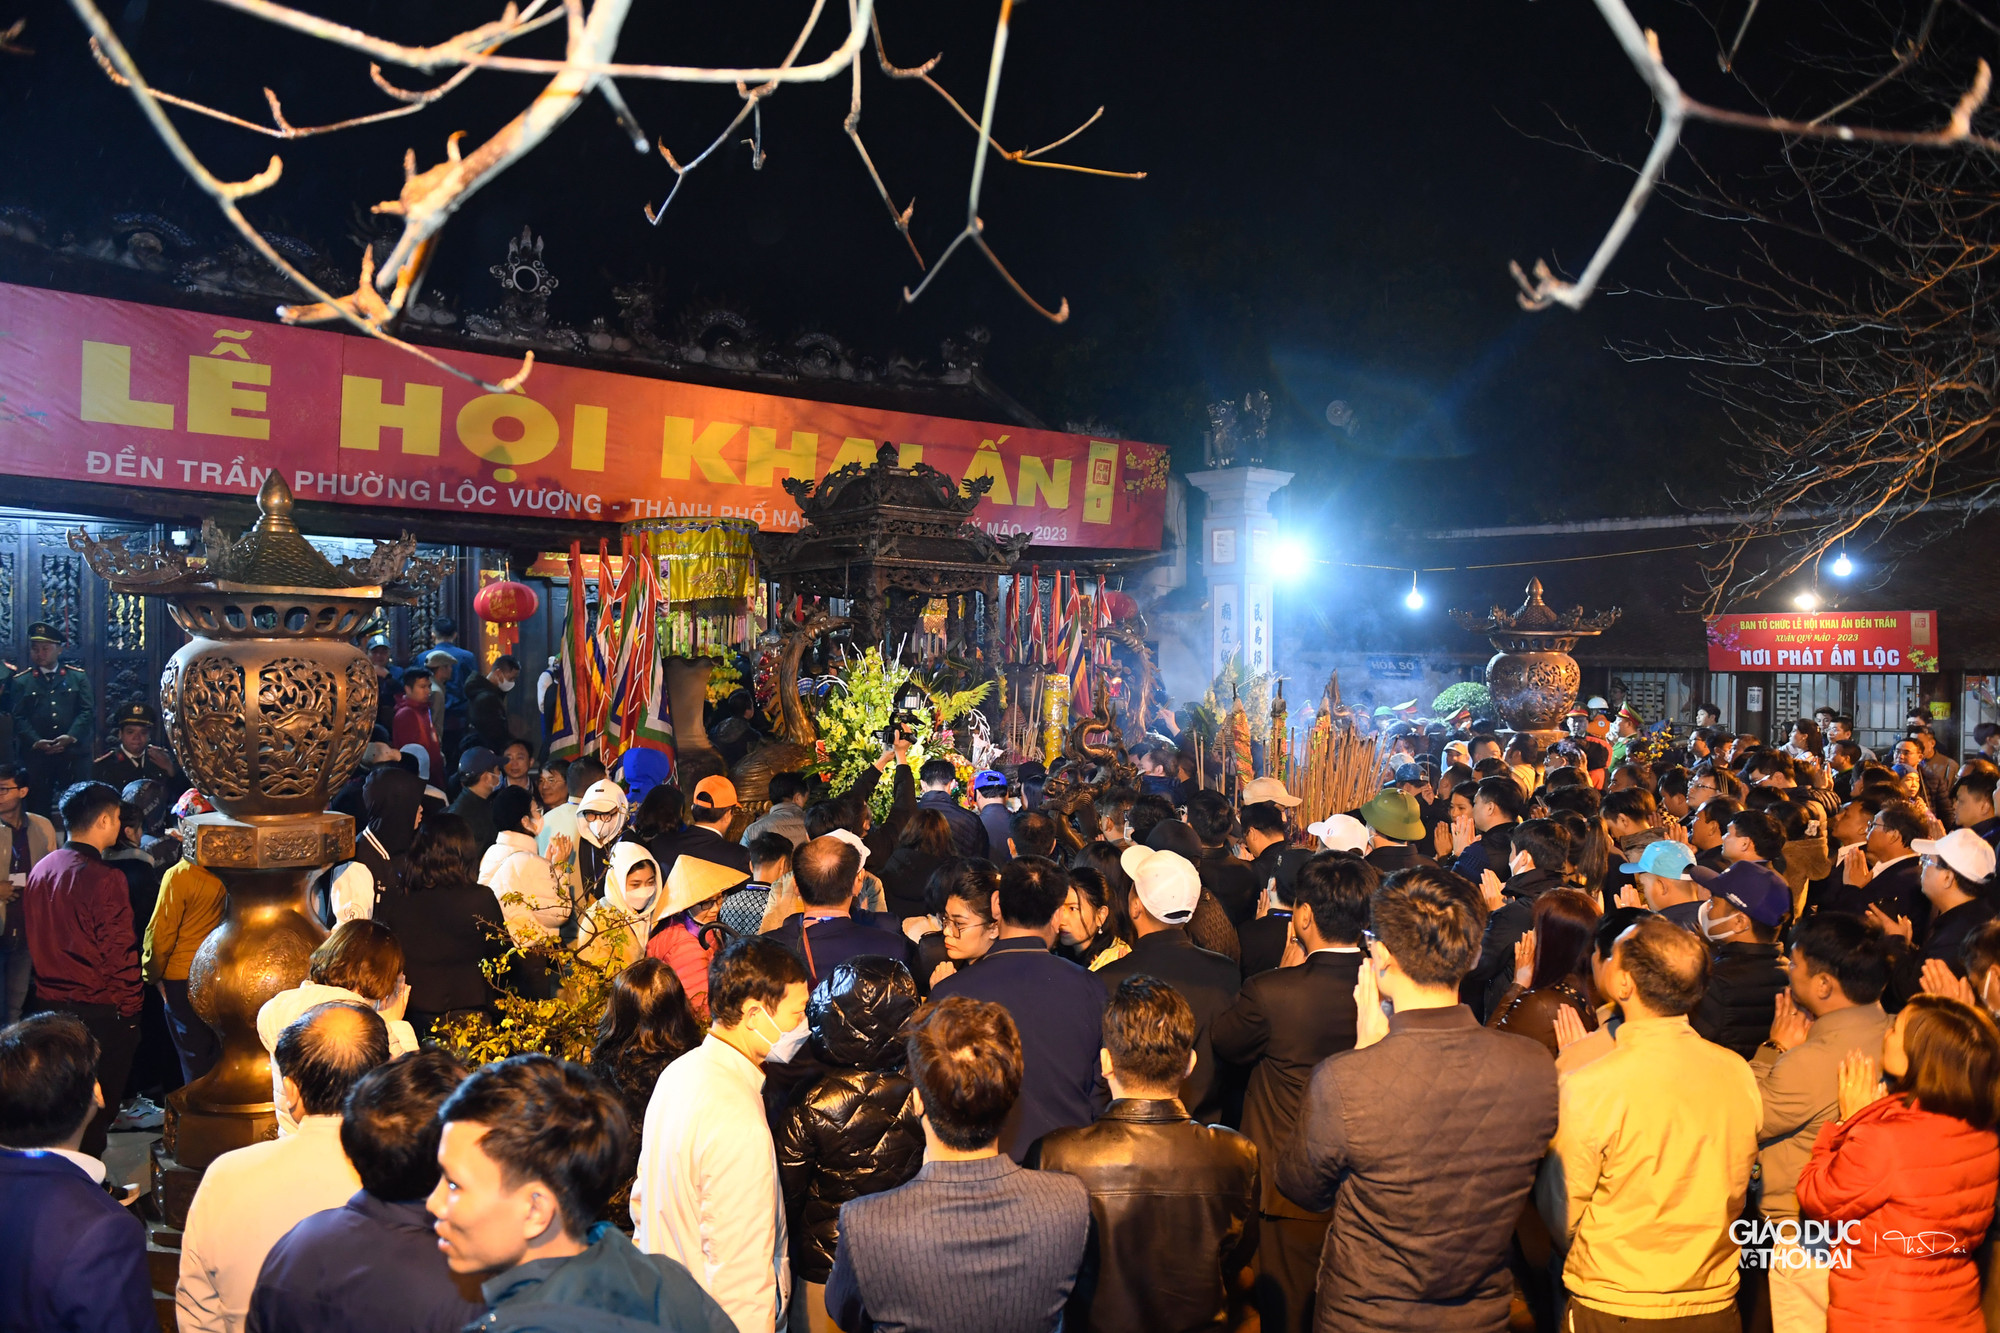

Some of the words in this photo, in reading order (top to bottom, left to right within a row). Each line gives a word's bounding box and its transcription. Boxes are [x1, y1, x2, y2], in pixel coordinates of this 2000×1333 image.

[81, 329, 271, 440] LỄ
[340, 375, 608, 483] HỘI
[959, 435, 1072, 509] ẤN
[86, 445, 163, 479] ĐỀN
[177, 456, 272, 487] TRẦN
[295, 471, 430, 500] PHƯỜNG
[440, 479, 496, 508] LỘC
[508, 487, 602, 514] VƯỢNG
[630, 496, 711, 517] THÀNH
[1034, 526, 1067, 541] 2023
[1740, 620, 1756, 630] BAN
[1758, 617, 1768, 629] TỔ
[1769, 618, 1791, 629] CHỨC
[1792, 617, 1802, 629] LỄ
[1804, 618, 1818, 631] HỘI
[1819, 619, 1839, 629] KHAI
[1841, 616, 1853, 629] ẤN
[1874, 616, 1897, 628] TRẦN
[1775, 634, 1795, 642] XUÂN
[1837, 634, 1859, 642] 2023
[1740, 648, 1771, 666] NƠI
[1777, 646, 1824, 666] PHÁT
[1830, 644, 1856, 666] ẤN
[1863, 646, 1900, 669] LỘC
